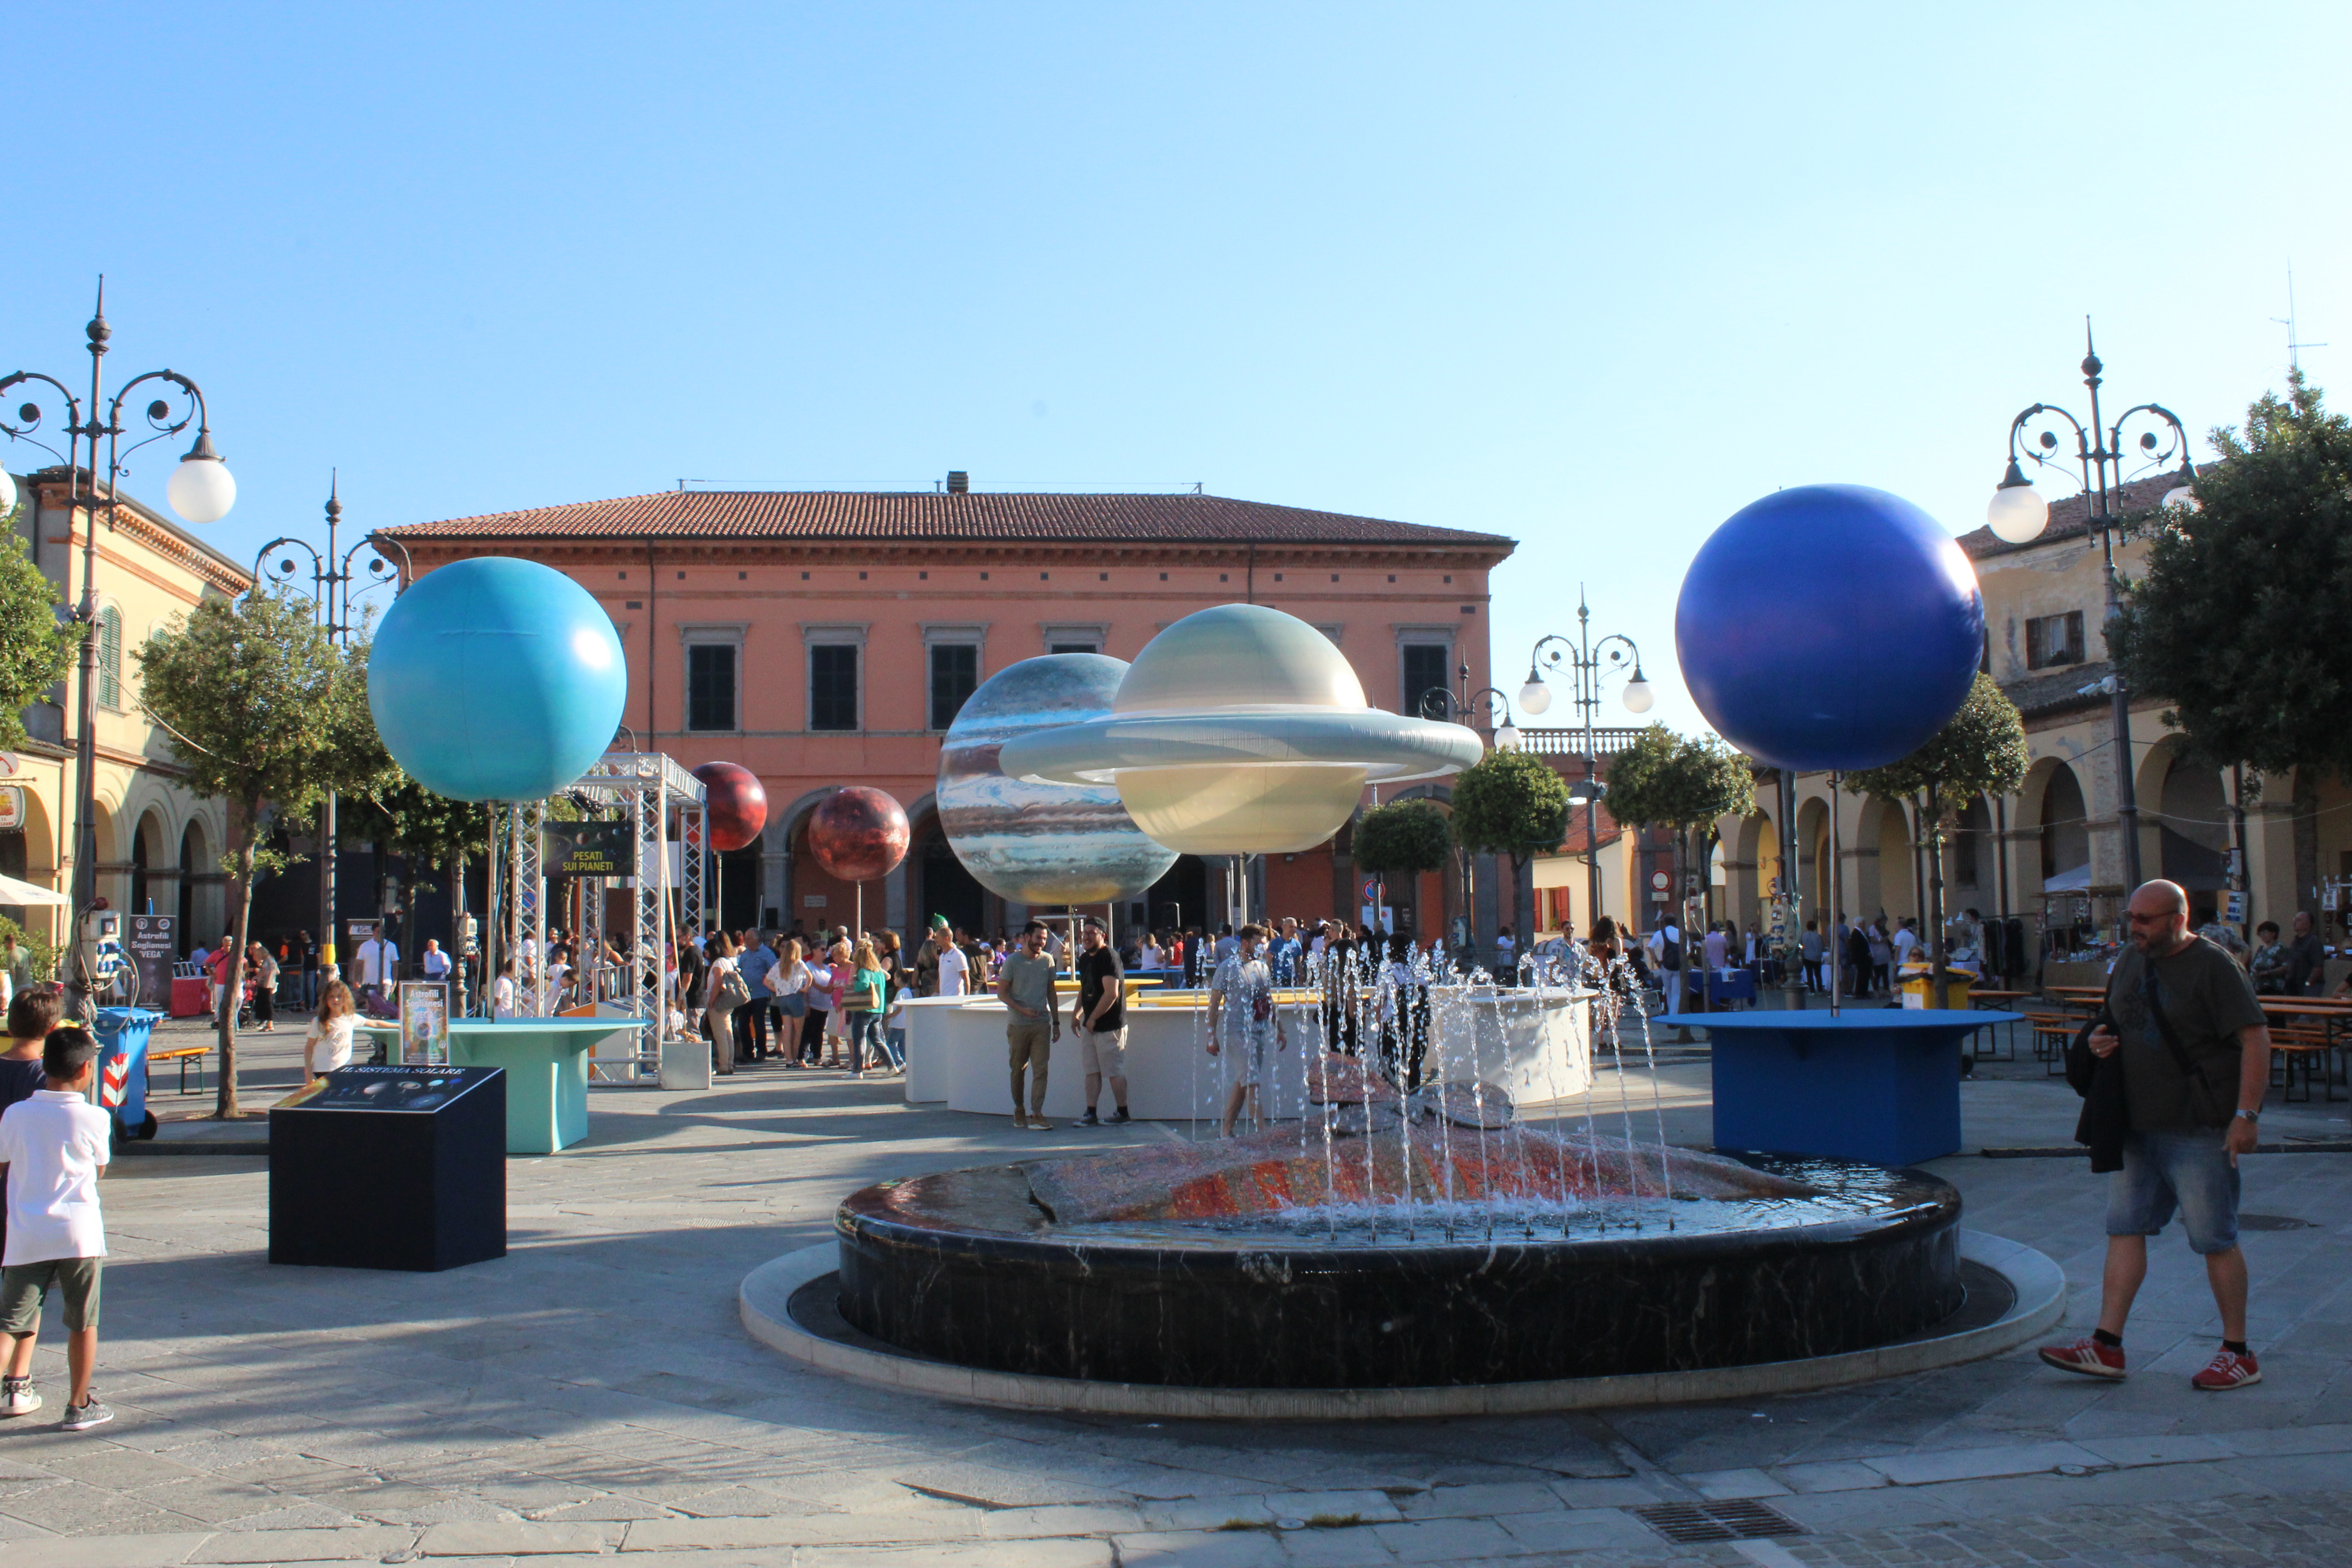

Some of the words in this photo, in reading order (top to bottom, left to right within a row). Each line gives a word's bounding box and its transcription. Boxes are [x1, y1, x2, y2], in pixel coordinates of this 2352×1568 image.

[573, 852, 602, 860] PESATI
[563, 862, 577, 871] SUI
[579, 862, 613, 871] PIANETI
[131, 941, 172, 950] Soglianesi
[410, 989, 439, 998] Astrofili
[407, 999, 443, 1008] Soglianesi
